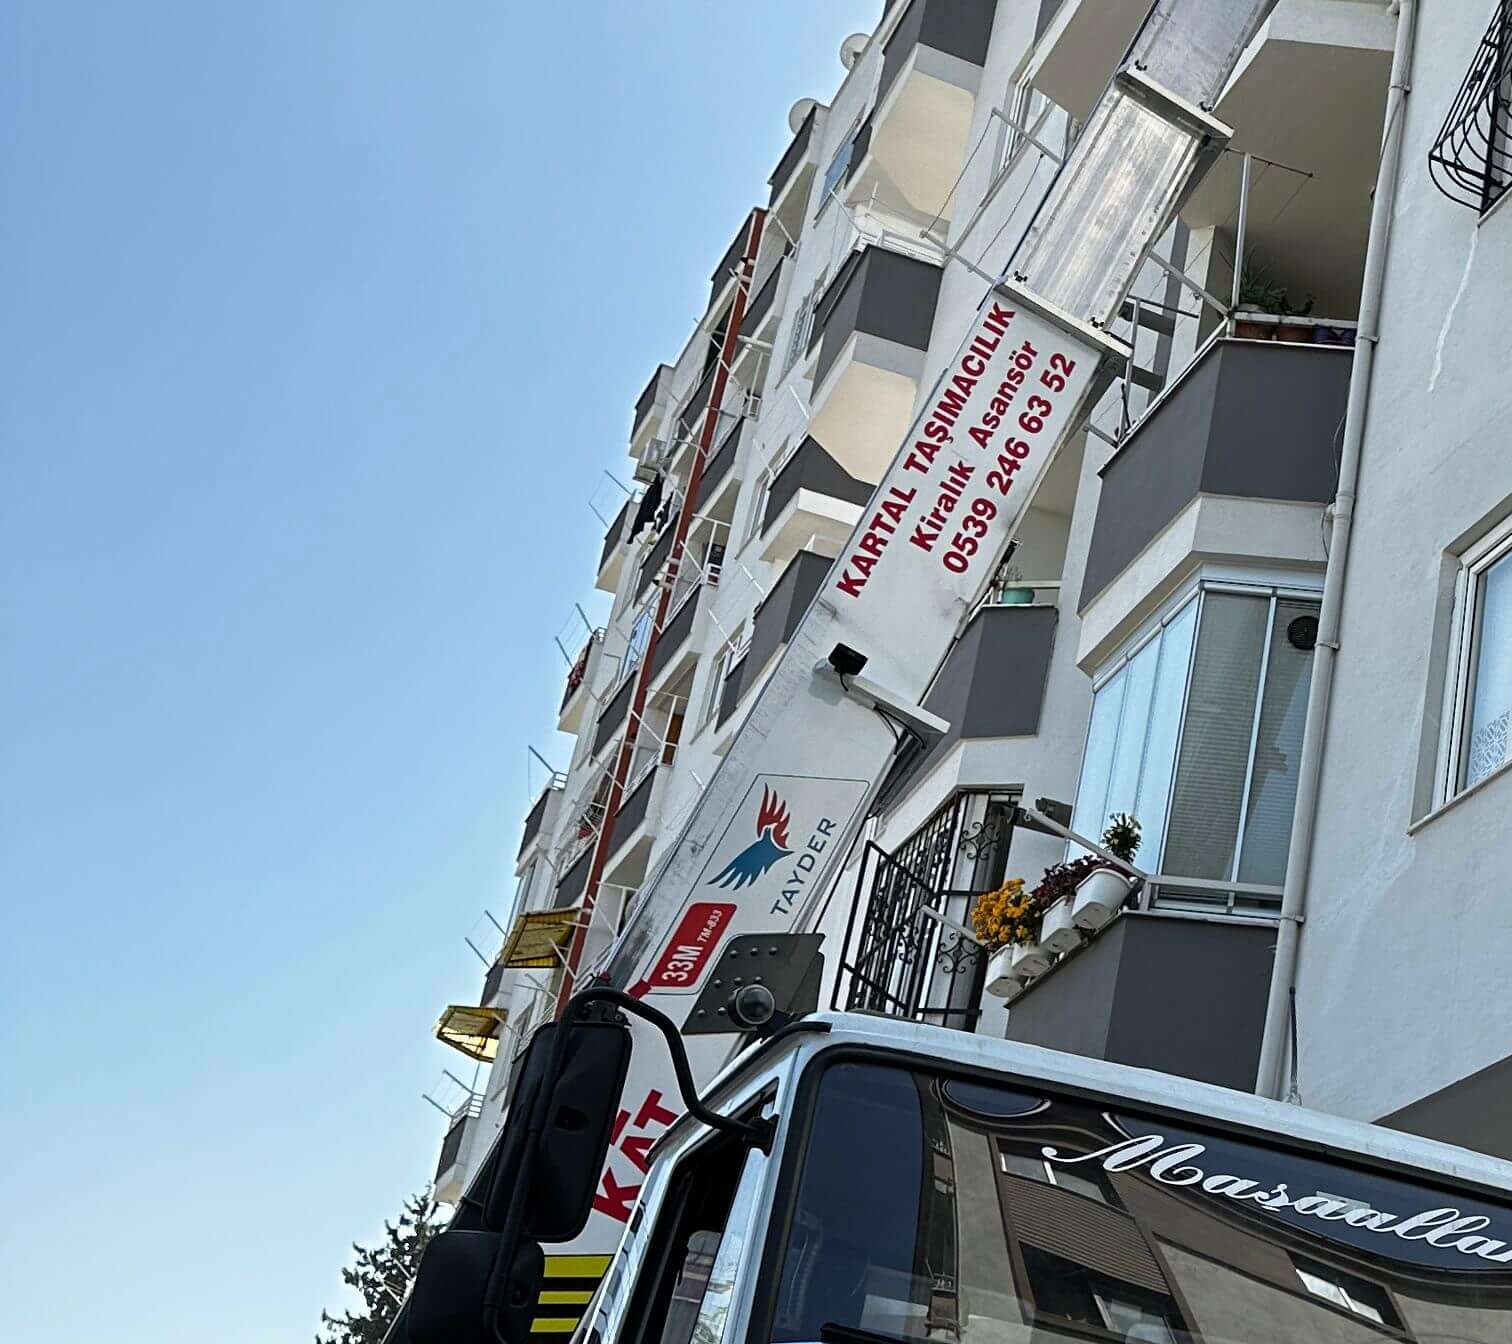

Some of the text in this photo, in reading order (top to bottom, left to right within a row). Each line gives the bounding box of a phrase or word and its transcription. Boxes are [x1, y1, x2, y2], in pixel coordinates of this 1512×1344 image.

[836, 302, 1016, 598] KARTAL TAŞIMACILIK
[909, 340, 1039, 552] Kiralık Asansör
[942, 352, 1076, 574] 0539 246 63 52
[770, 817, 837, 916] TAYDER
[661, 945, 704, 982] 33M
[592, 1089, 680, 1223] KAT
